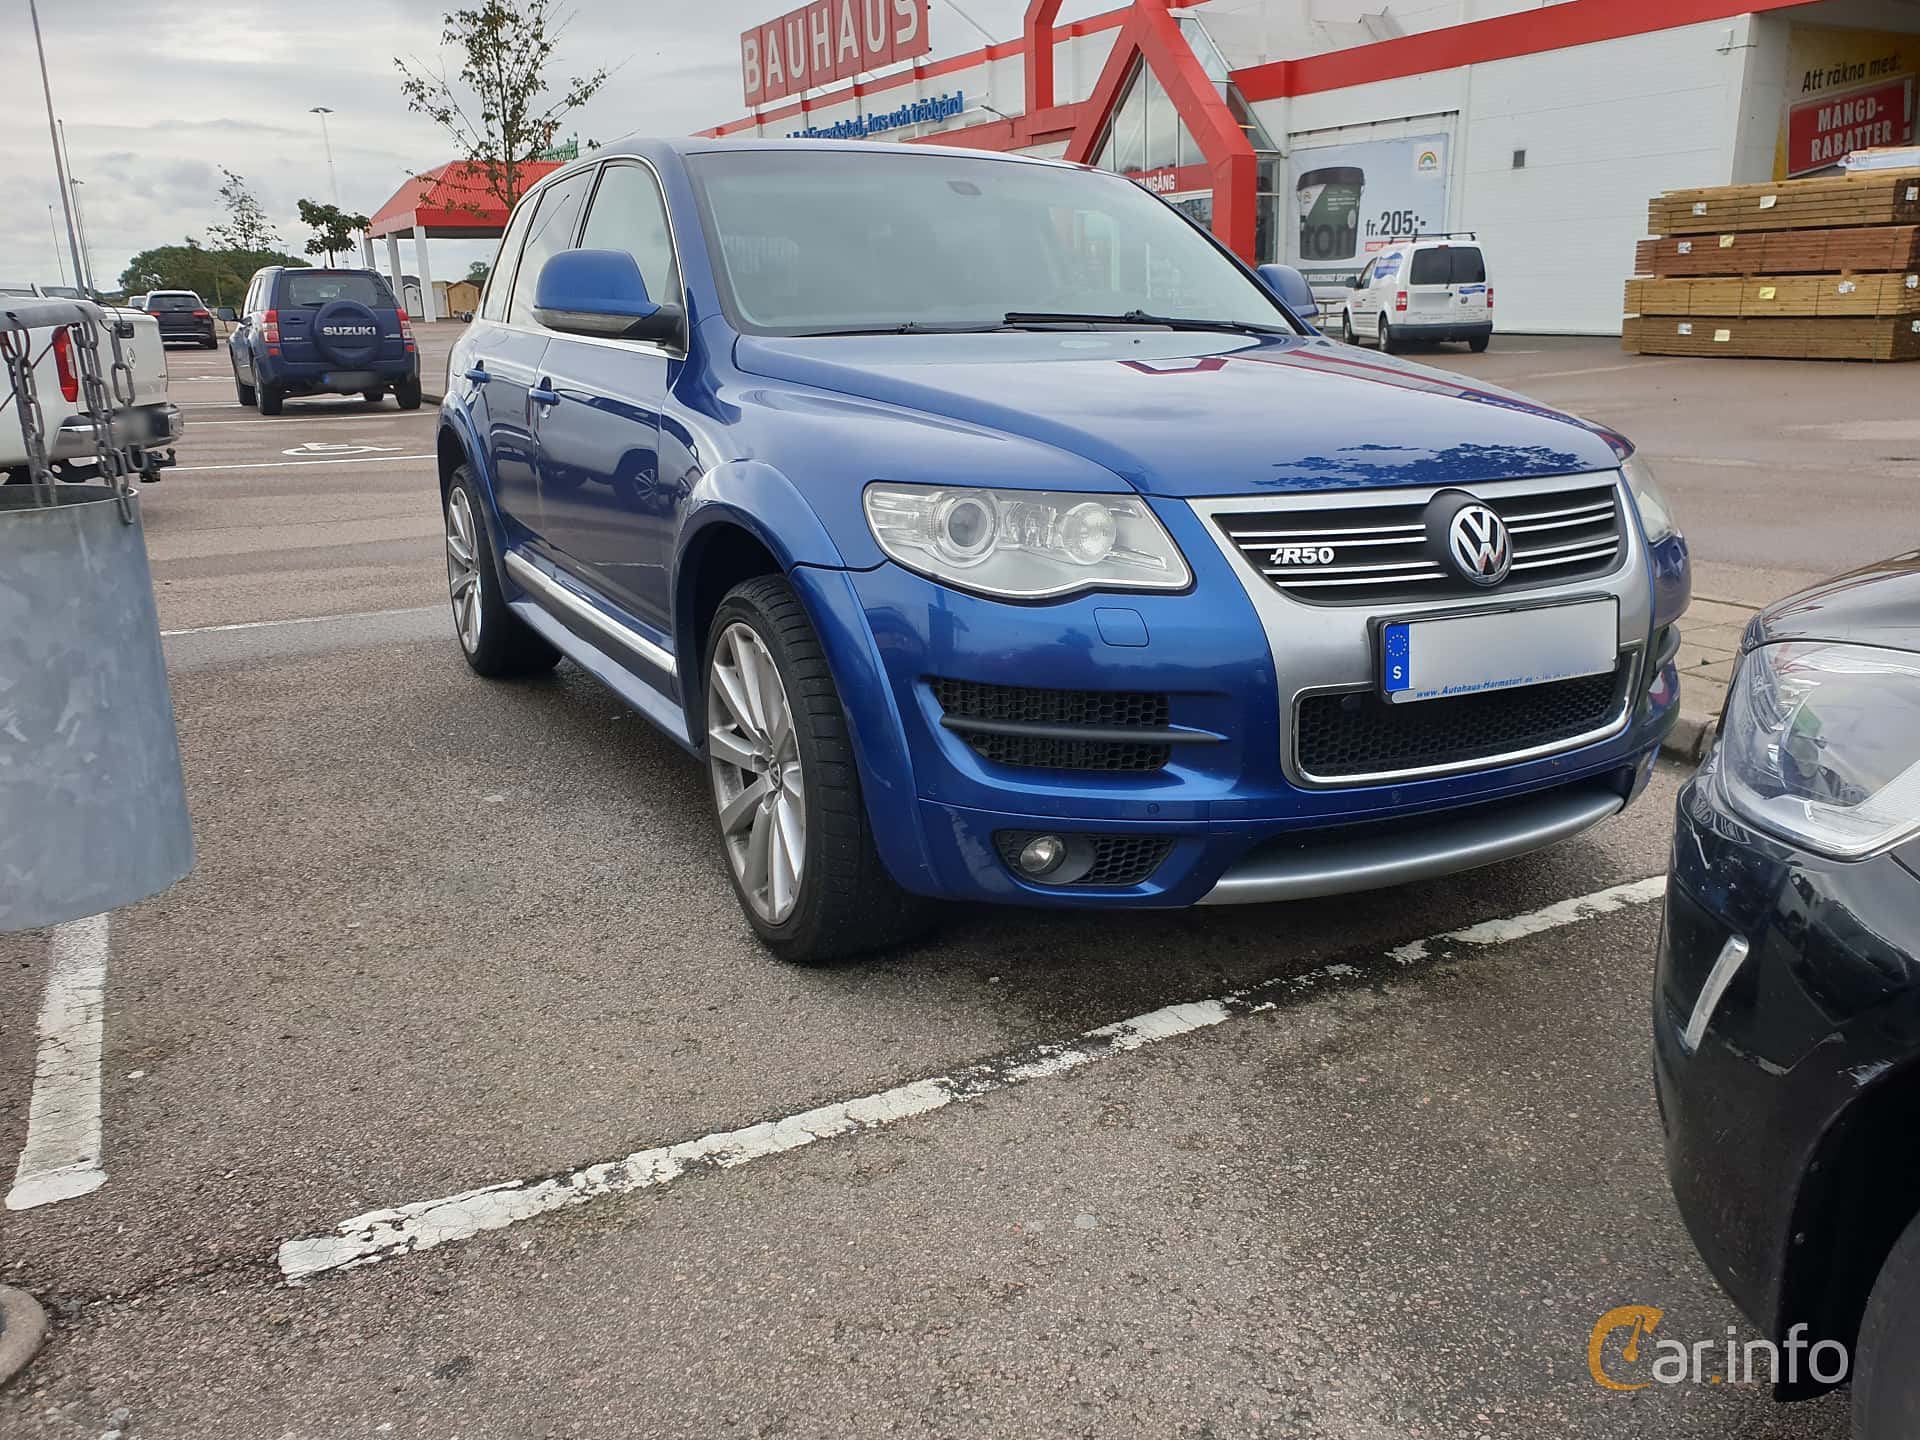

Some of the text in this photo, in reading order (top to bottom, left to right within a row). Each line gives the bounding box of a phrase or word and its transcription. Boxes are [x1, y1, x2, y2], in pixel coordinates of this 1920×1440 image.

[743, 0, 919, 94] BAUHAUS
[1801, 68, 1824, 93] Att
[1826, 62, 1865, 87] räkna
[911, 90, 964, 123] trädgård
[1817, 97, 1884, 133] MÄNGD-
[1811, 119, 1892, 162] RABATTER
[1366, 219, 1379, 237] fr.
[323, 326, 377, 336] SUZUKI
[1392, 665, 1403, 680] S
